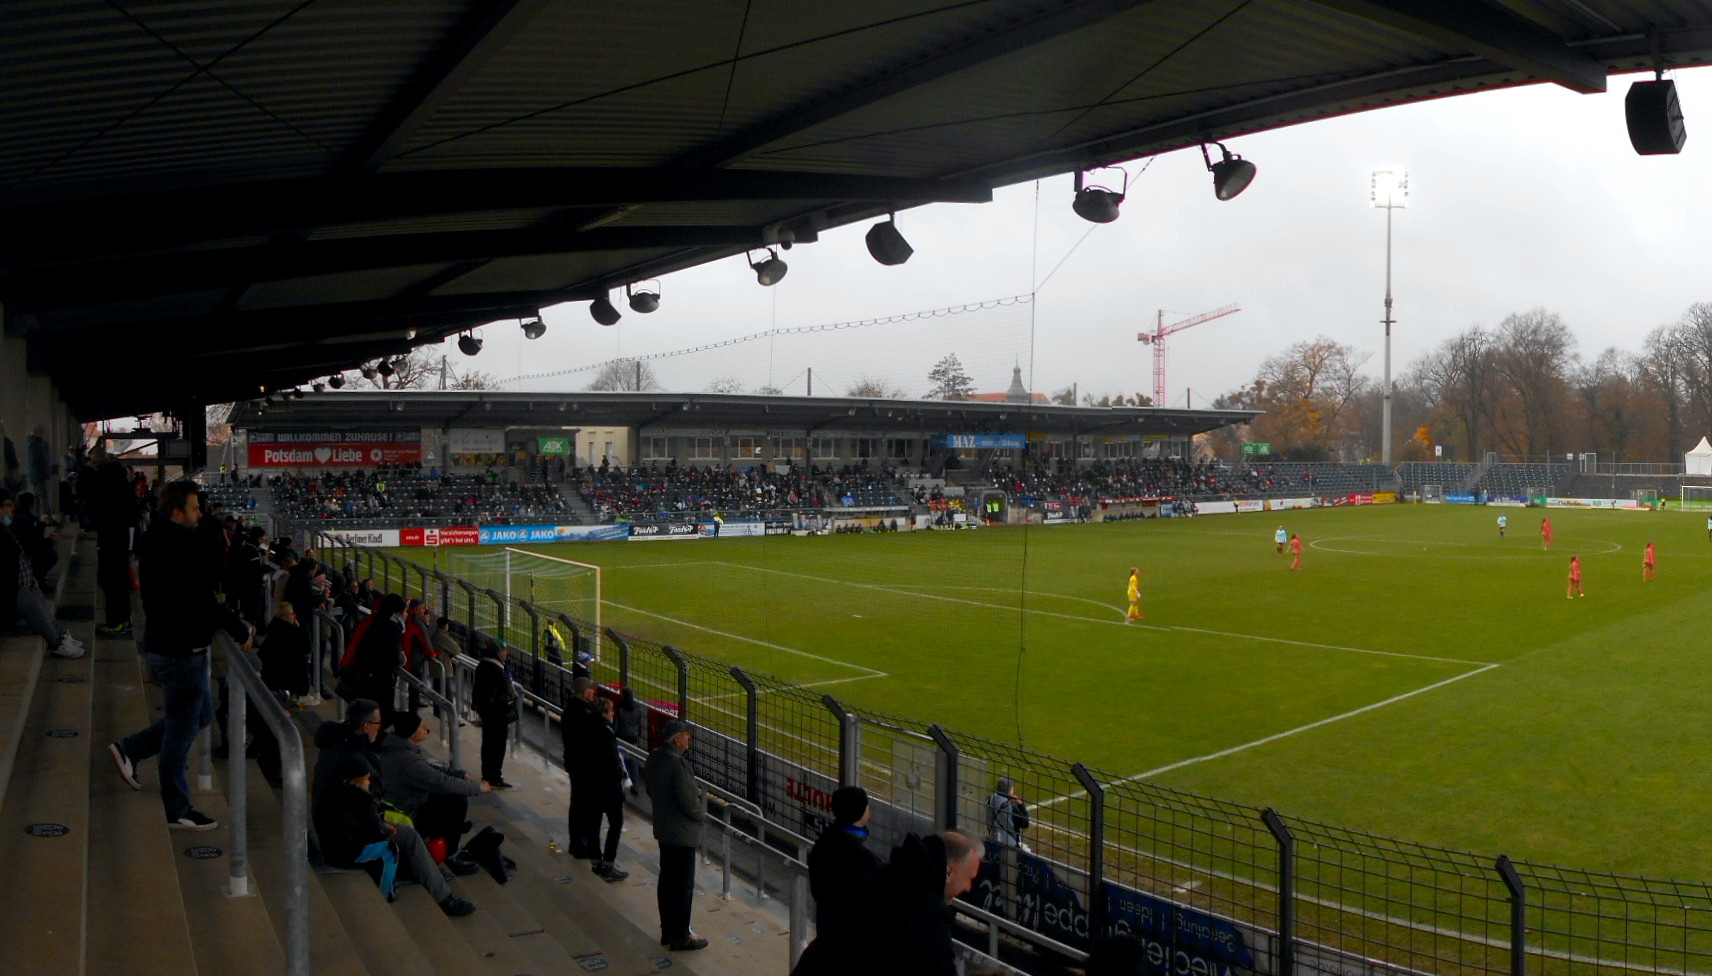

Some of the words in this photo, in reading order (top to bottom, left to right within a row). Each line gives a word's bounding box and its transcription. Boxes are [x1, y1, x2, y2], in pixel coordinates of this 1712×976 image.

[277, 432, 342, 442] WILLKOMMEN
[345, 432, 393, 442] ZUHAUSE!
[543, 441, 563, 450] AOK
[264, 449, 313, 463] Potsdam
[333, 448, 363, 462] Liebe
[345, 533, 367, 544] Berliner
[368, 533, 382, 543] Kindl
[492, 530, 517, 540] JAKO
[529, 529, 554, 540] JAKO
